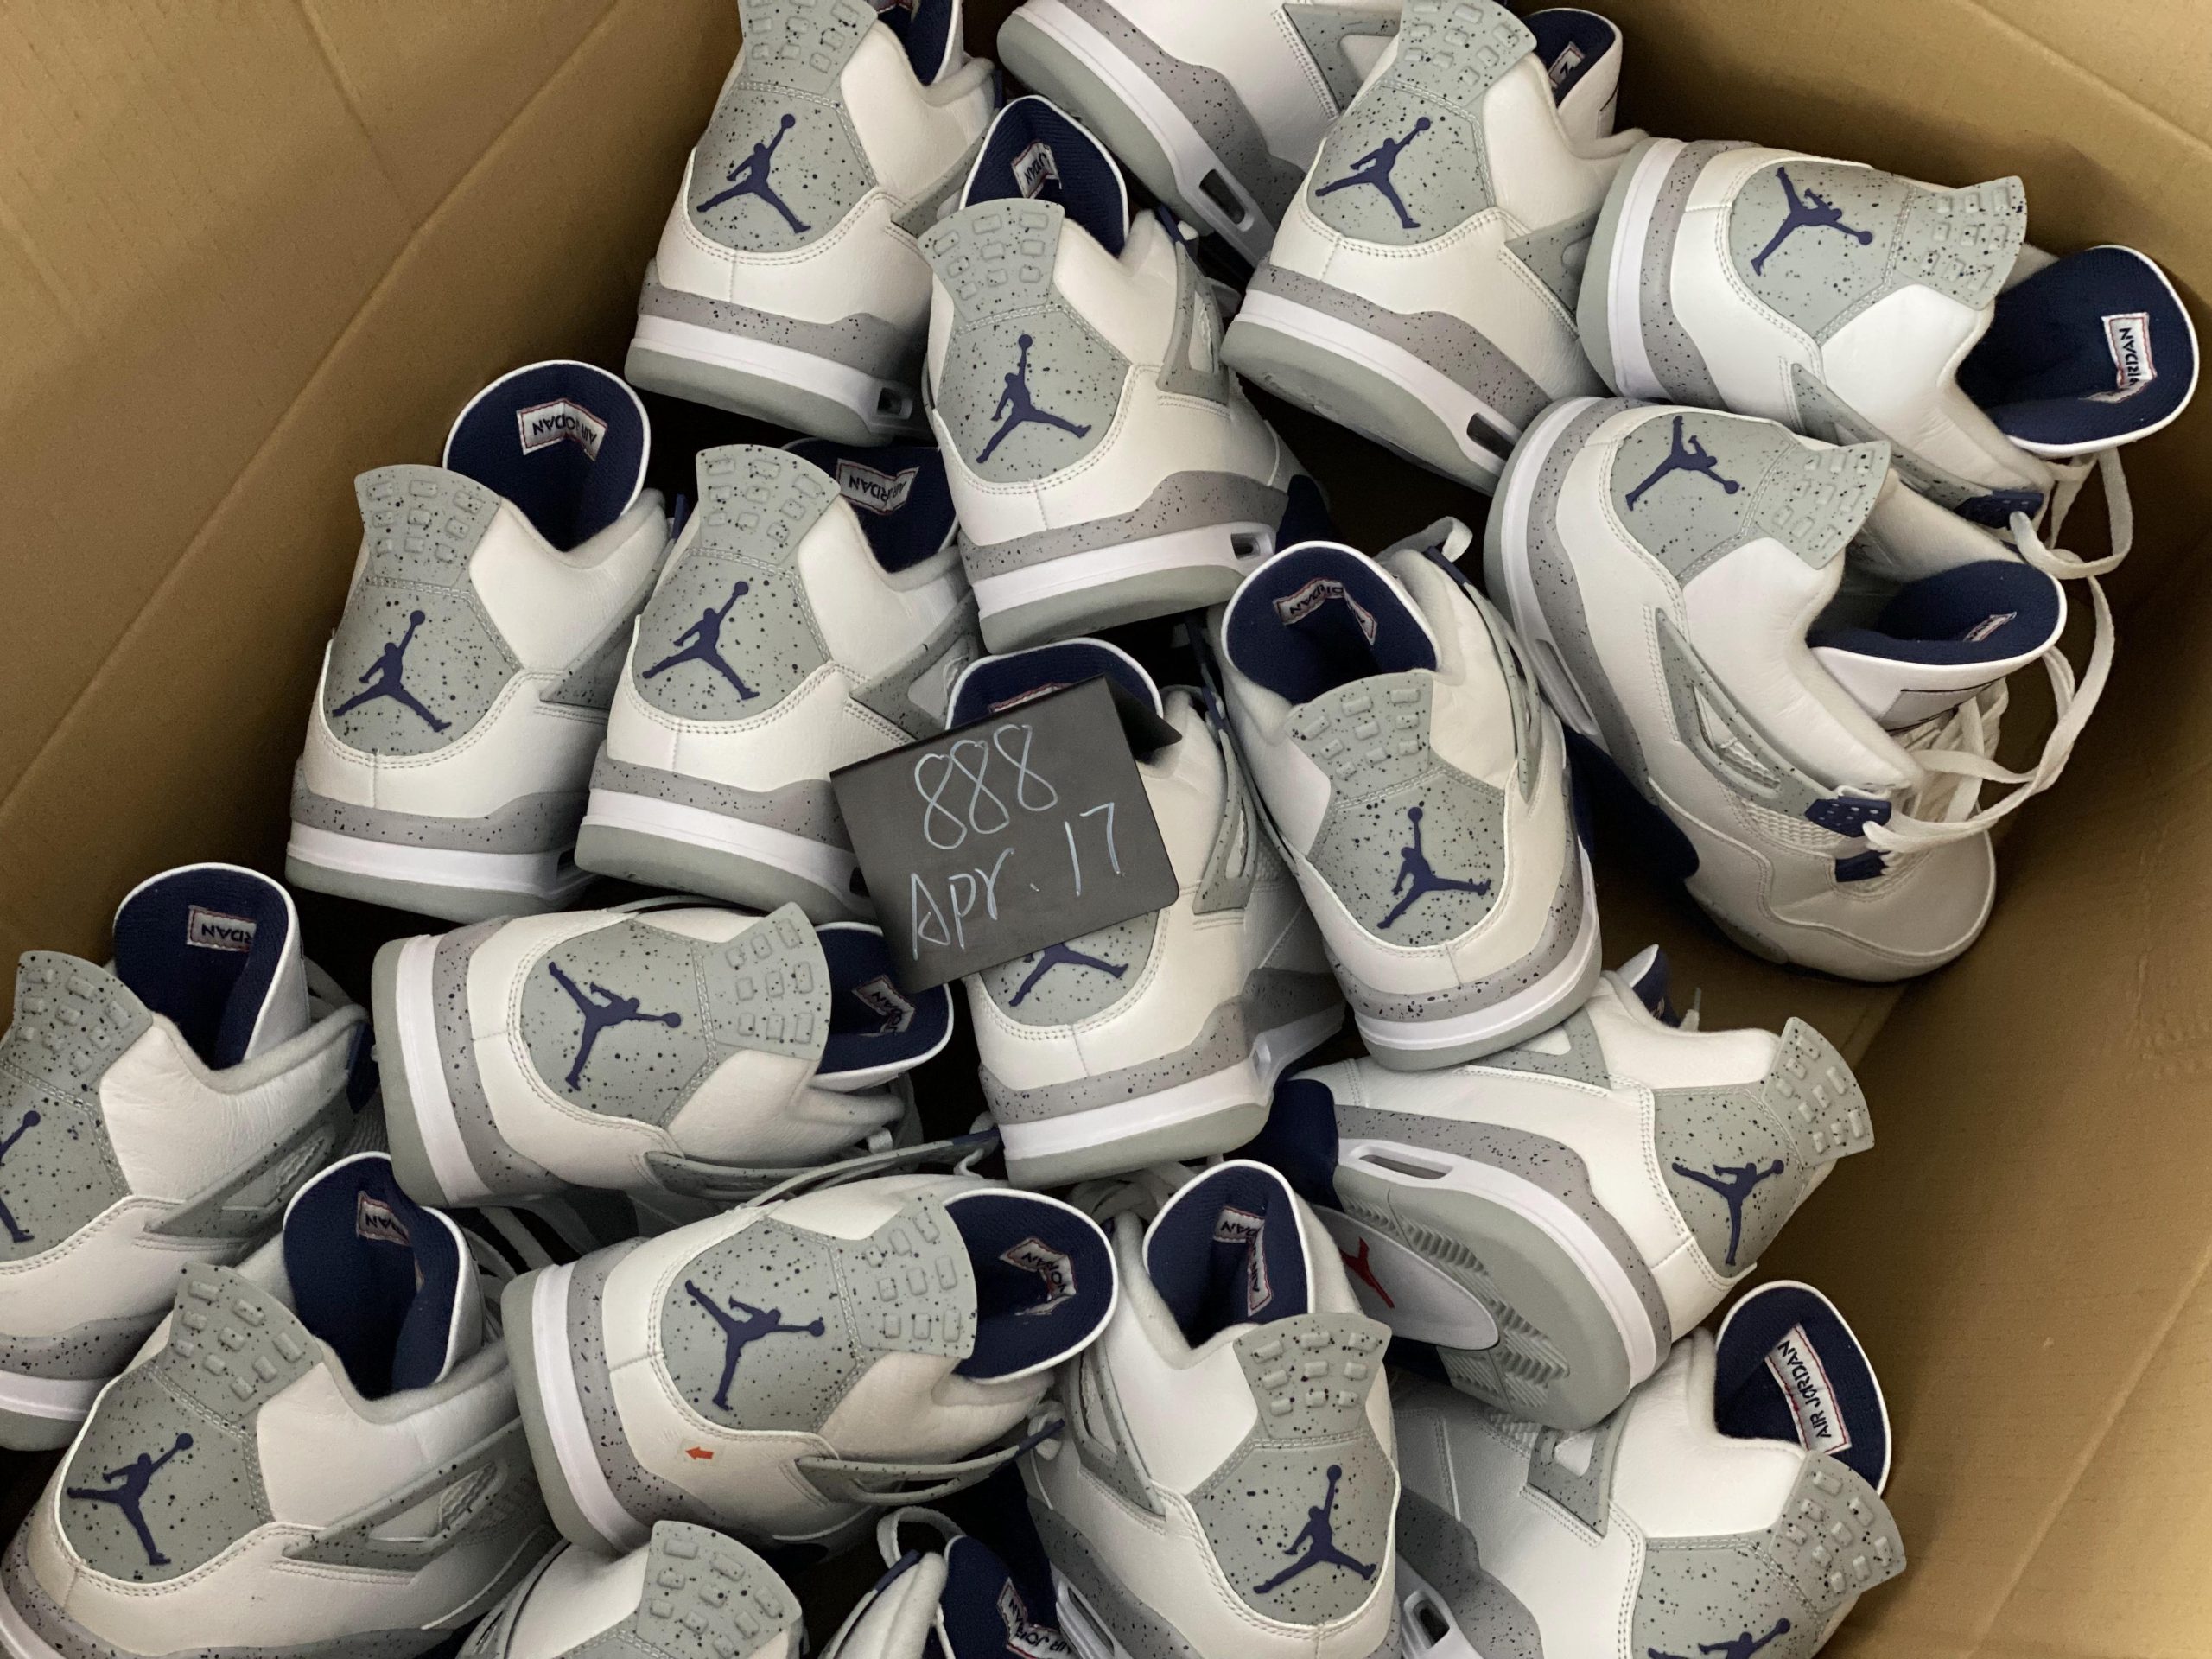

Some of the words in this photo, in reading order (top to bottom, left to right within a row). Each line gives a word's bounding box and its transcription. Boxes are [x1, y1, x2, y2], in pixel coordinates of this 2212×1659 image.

[914, 723, 1058, 850] 888
[910, 847, 1040, 961] Apr.
[1064, 802, 1123, 898] 17
[1777, 1340, 1821, 1408] JORDAN
[1809, 1410, 1832, 1438] AIR
